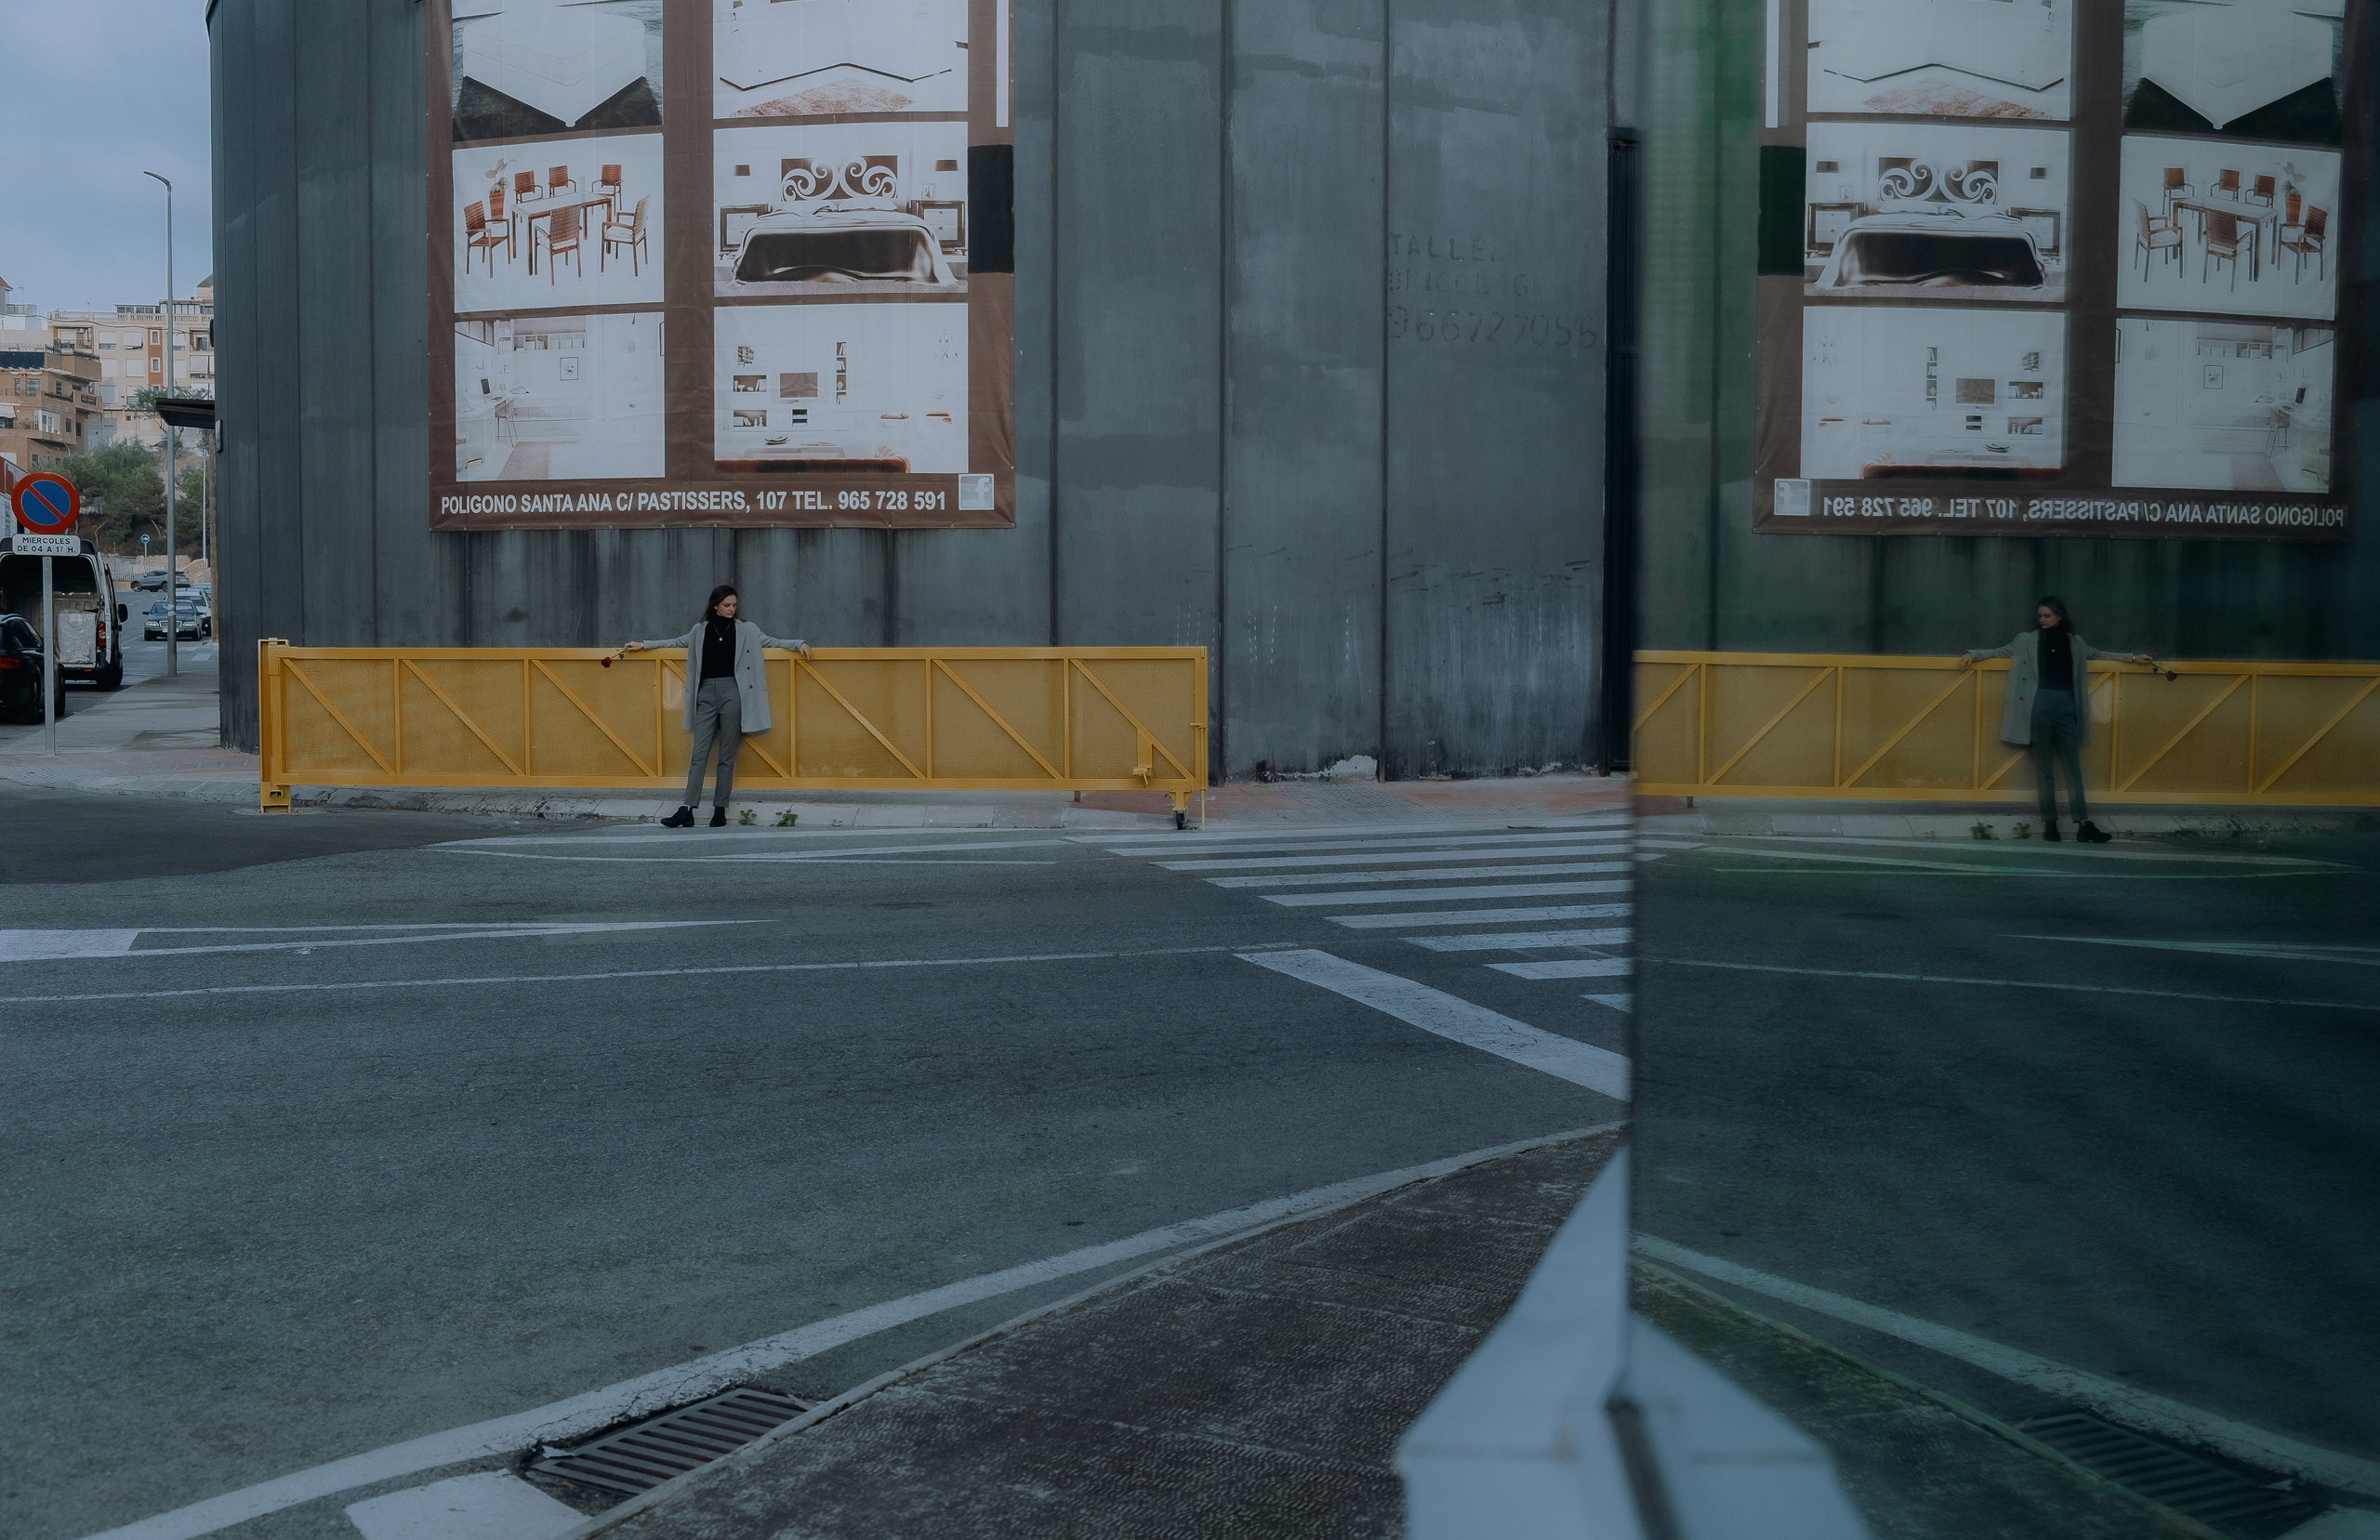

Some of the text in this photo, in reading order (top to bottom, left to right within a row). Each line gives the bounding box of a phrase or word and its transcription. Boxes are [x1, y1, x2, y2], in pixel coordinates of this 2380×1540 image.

[442, 491, 945, 514] POLIGONO SANTA ANA C/ PASTISSERS, 107 TEL. 965 728 591
